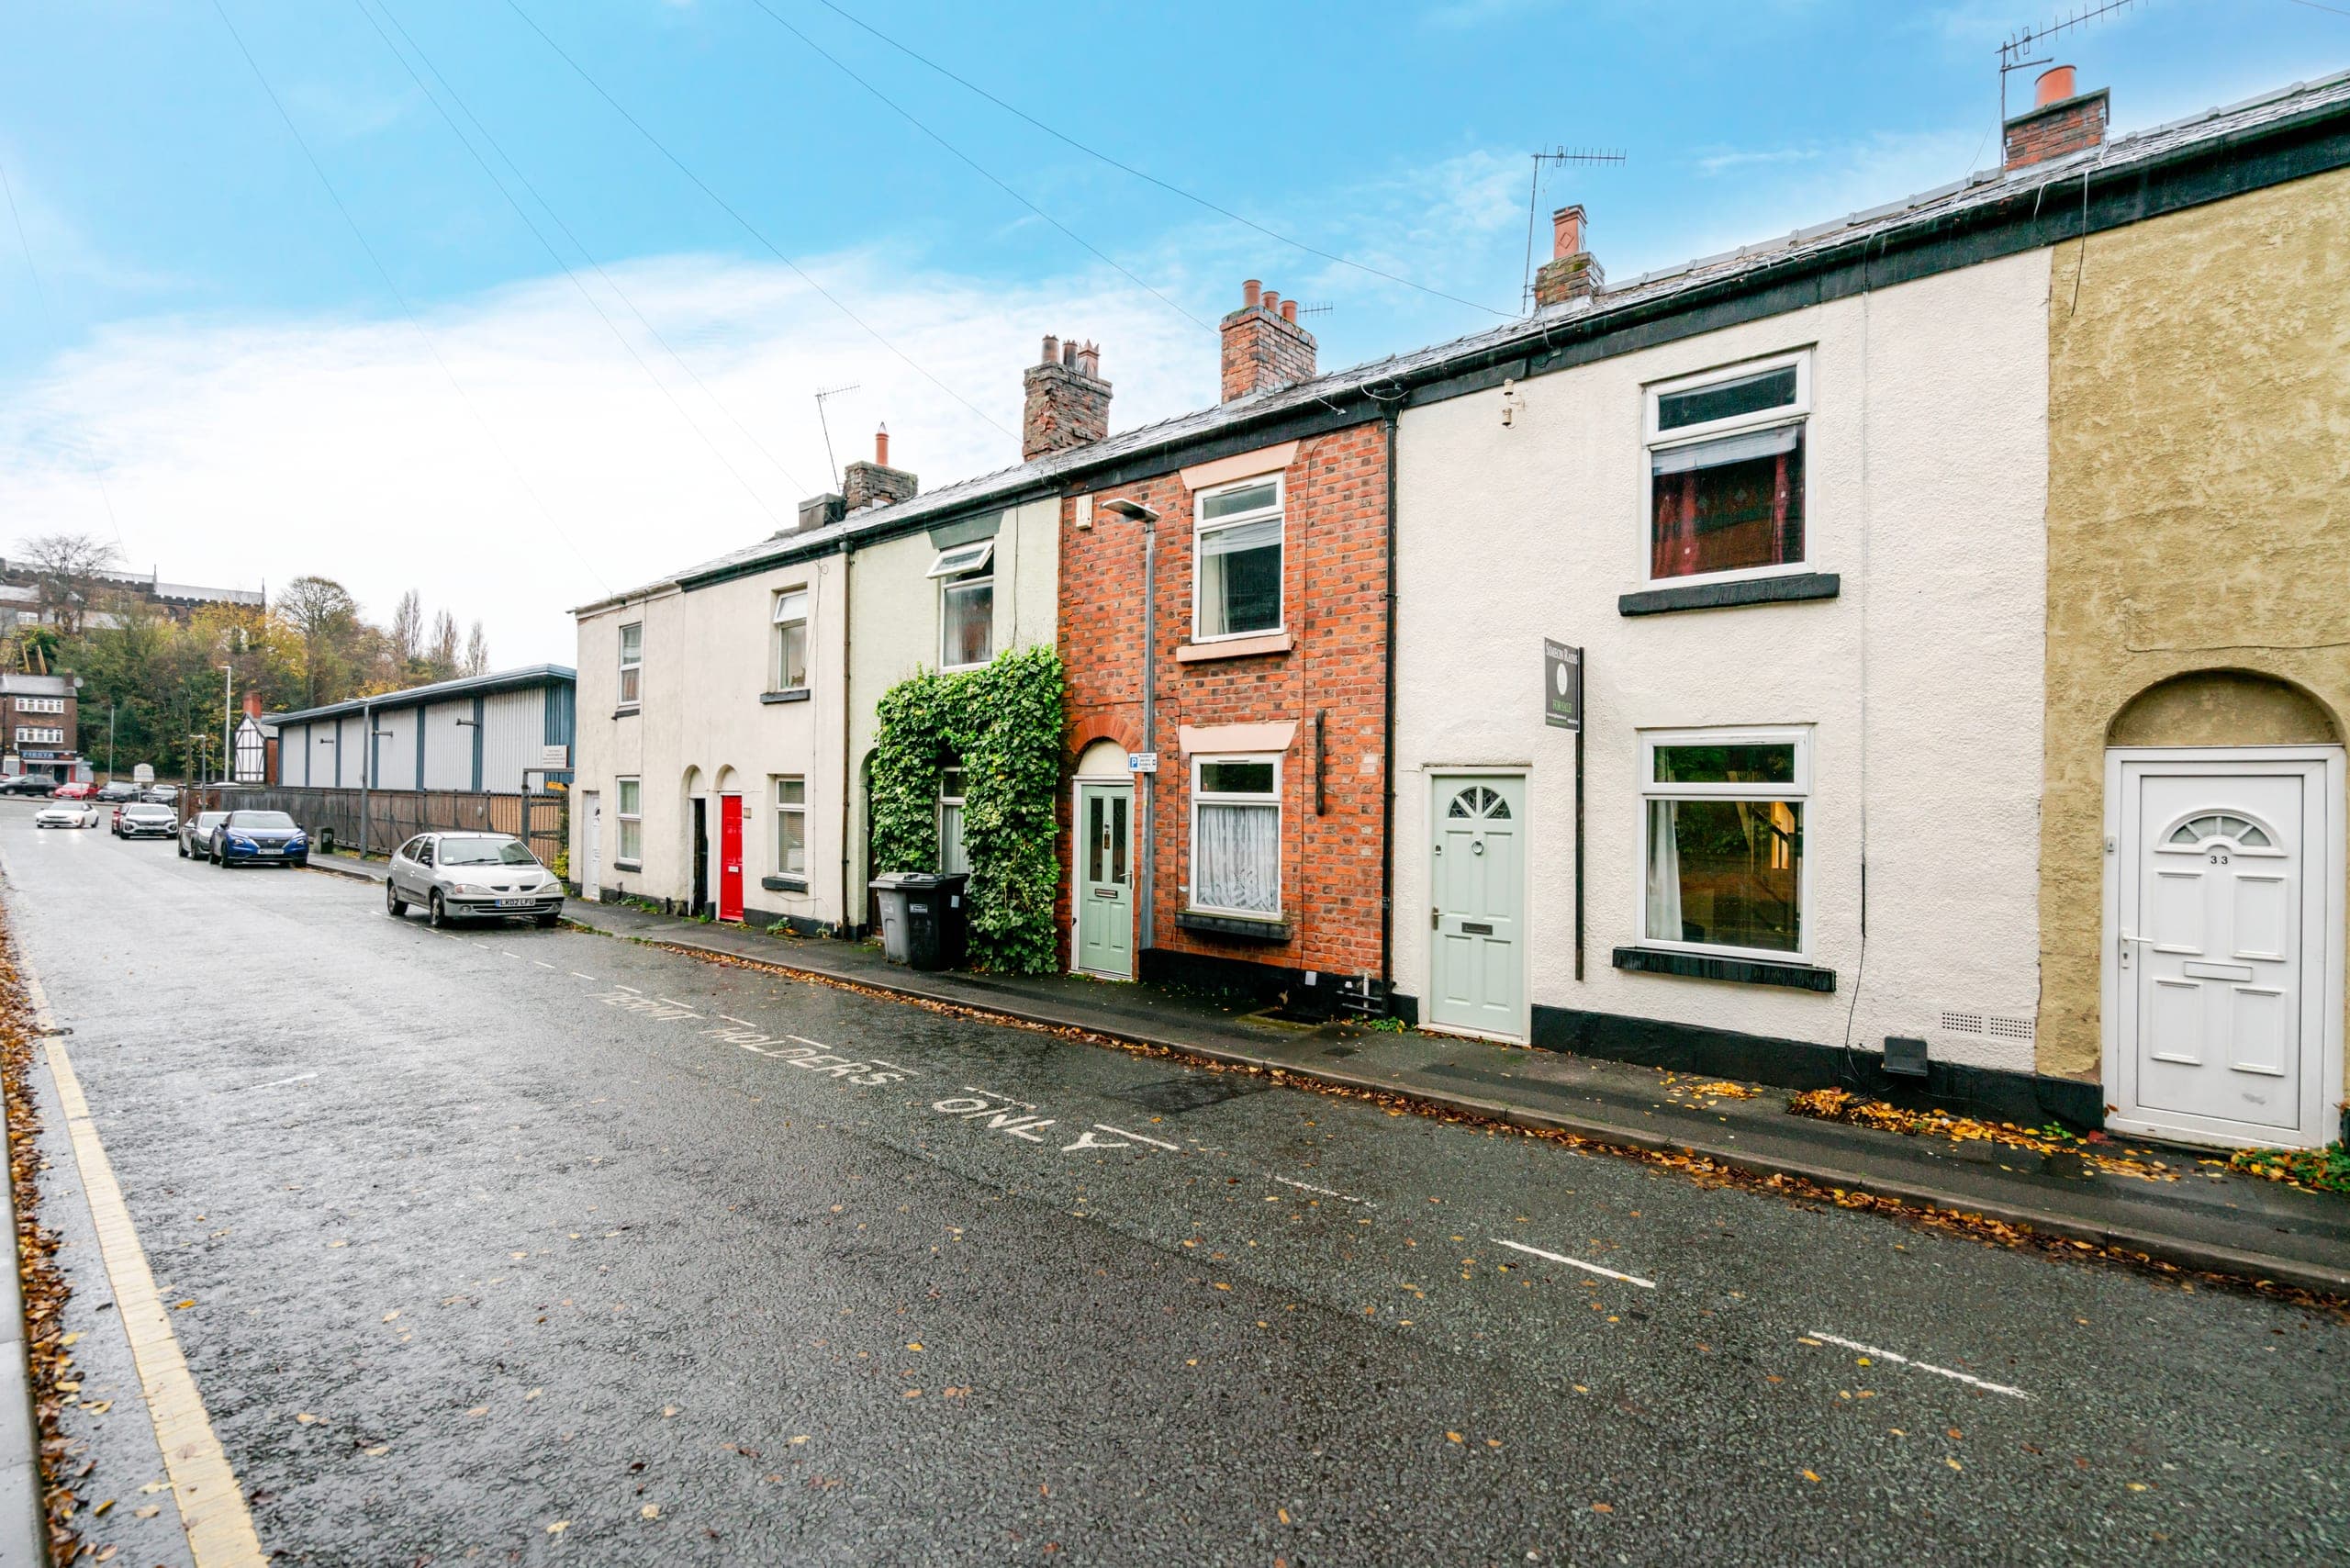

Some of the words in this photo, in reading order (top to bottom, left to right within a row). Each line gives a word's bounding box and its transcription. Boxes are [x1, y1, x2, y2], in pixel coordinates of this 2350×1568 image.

[23, 751, 54, 759] FIESTA
[2210, 855, 2228, 864] 33
[584, 991, 707, 1021] PERMIT
[698, 1027, 905, 1085] HOLDERS
[932, 1098, 1131, 1152] ONLY
